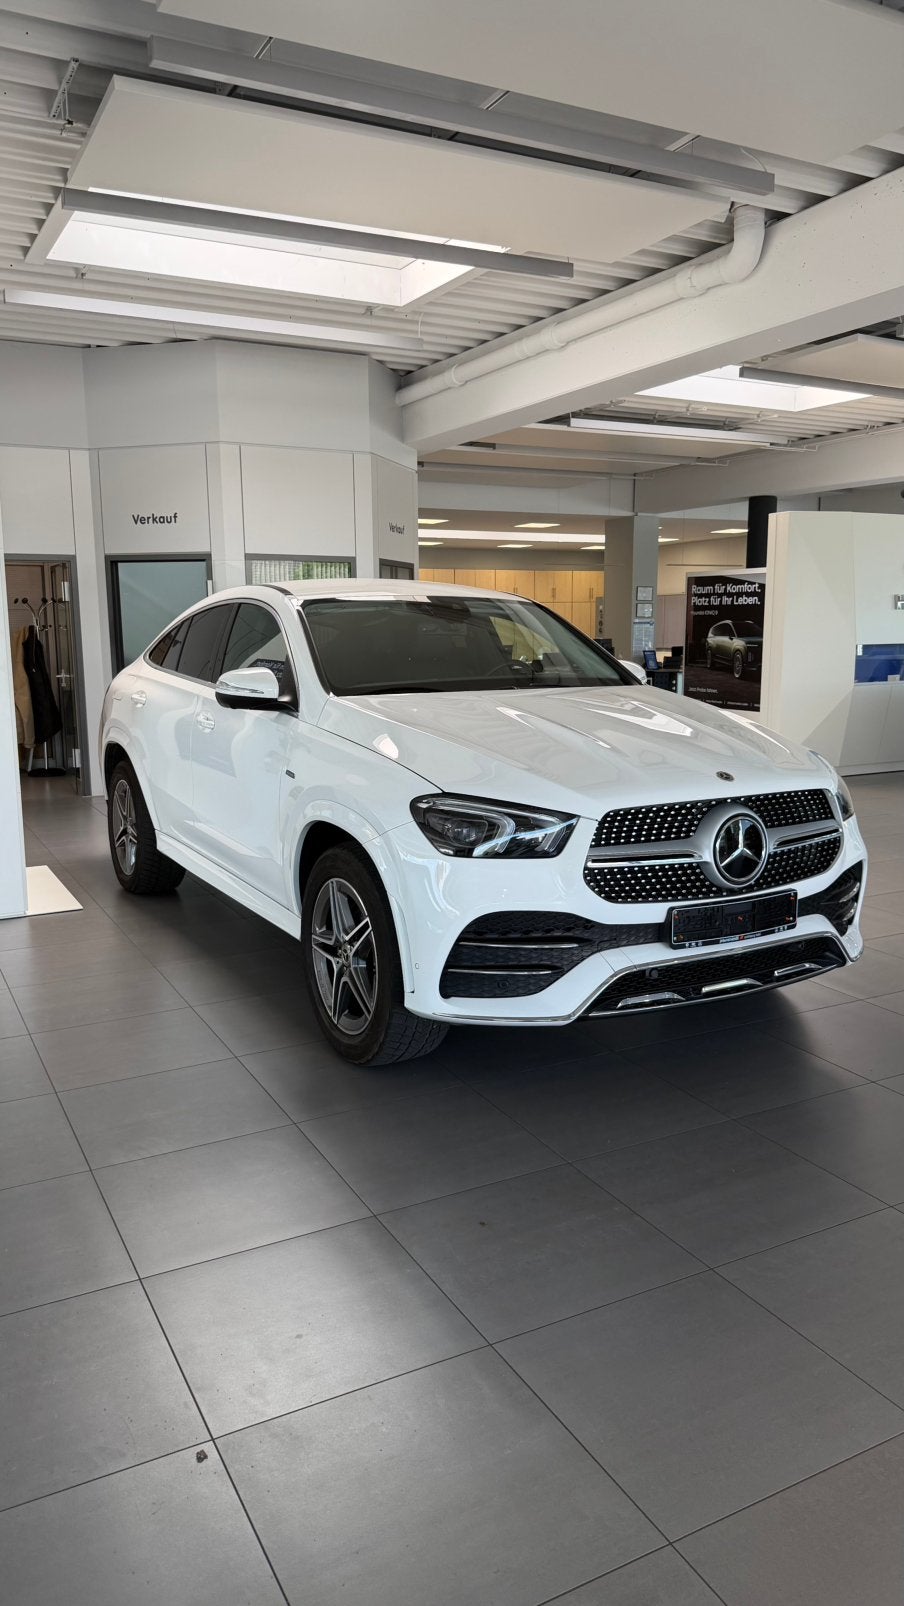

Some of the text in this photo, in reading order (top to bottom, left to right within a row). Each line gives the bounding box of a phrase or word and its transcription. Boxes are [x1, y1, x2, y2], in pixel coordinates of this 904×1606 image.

[132, 512, 178, 525] Verkauf
[389, 521, 405, 535] Verkauf
[691, 582, 761, 594] Raum für Komfort.
[691, 594, 761, 606] Platz für Ihr Leben.
